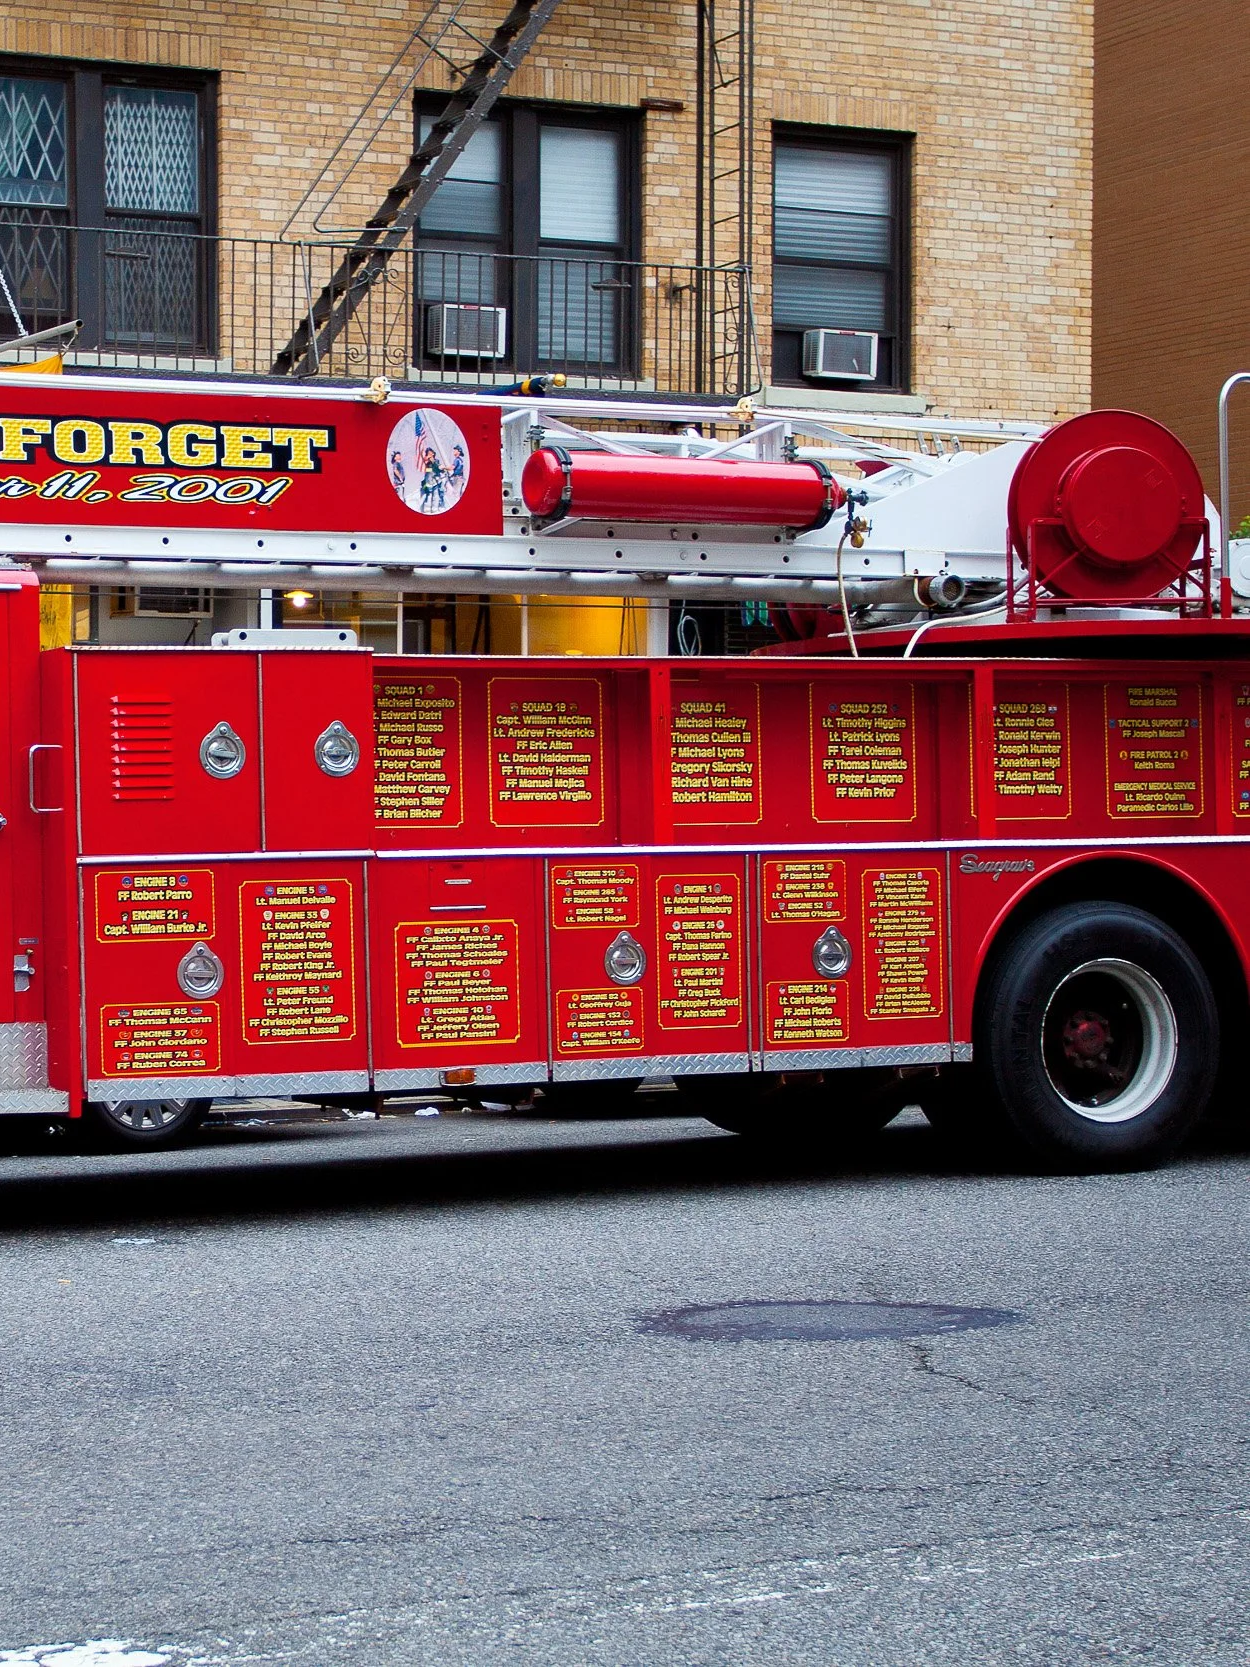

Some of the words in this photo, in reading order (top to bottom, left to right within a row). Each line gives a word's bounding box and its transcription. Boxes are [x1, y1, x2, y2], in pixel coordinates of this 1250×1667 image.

[40, 471, 112, 503] 11,
[119, 474, 291, 503] 2001
[384, 686, 415, 695] SQUAD
[418, 686, 424, 694] 1
[522, 703, 552, 712] SQUAD
[556, 703, 566, 712] 18
[840, 704, 869, 714] SQUAD
[872, 704, 888, 714] 252
[496, 716, 520, 726] Capt.
[522, 716, 556, 725] William
[822, 718, 833, 728] Lt.
[836, 718, 872, 729] Timothy
[874, 718, 906, 729] Higgins
[493, 728, 505, 737] Lt.
[508, 728, 544, 737] Andrew
[546, 728, 595, 737] Fredericks
[829, 732, 840, 742] Lt.
[842, 732, 874, 742] Patrick
[876, 732, 900, 743] Lyons
[516, 741, 527, 750] FF
[530, 741, 547, 750] Eric
[548, 740, 573, 750] Allen
[828, 746, 838, 755] FF
[864, 746, 902, 755] Coleman
[498, 754, 510, 762] Lt.
[512, 754, 539, 762] David
[822, 760, 833, 769] FF
[834, 760, 870, 769] Thomas
[501, 766, 513, 775] FF
[514, 766, 554, 776] Timothy
[556, 766, 589, 775] Haskell
[506, 779, 517, 788] FF
[518, 778, 553, 788] Manuel
[554, 778, 585, 789] Mojica
[827, 774, 838, 783] FF
[840, 774, 865, 783] Peter
[866, 774, 903, 785] Langone
[499, 791, 511, 800] FF
[512, 791, 557, 800] Lawrence
[836, 788, 847, 797] FF
[848, 788, 872, 797] Kevin
[874, 787, 896, 797] Prior
[959, 853, 1036, 881] Seagrave
[134, 877, 167, 887] ENGINE
[168, 877, 176, 886] 8
[118, 891, 129, 900] FF
[130, 891, 164, 900] Robert
[166, 890, 192, 899] Parro
[132, 910, 165, 920] ENGINE
[166, 910, 179, 919] 21
[104, 925, 129, 936] Capt.
[130, 924, 165, 934] William
[166, 924, 195, 933] Burke
[196, 923, 208, 933] Jr.
[788, 985, 813, 994] ENGINE
[814, 985, 827, 993] 214
[790, 996, 804, 1004] Carl
[783, 1007, 792, 1016] FF
[792, 1007, 810, 1015] John
[774, 1018, 783, 1027] FF
[784, 1018, 812, 1027] Michael
[812, 1018, 841, 1027] Roberts
[774, 1030, 782, 1039] FF
[784, 1030, 814, 1039] Kenneth
[814, 1029, 842, 1038] Watson
